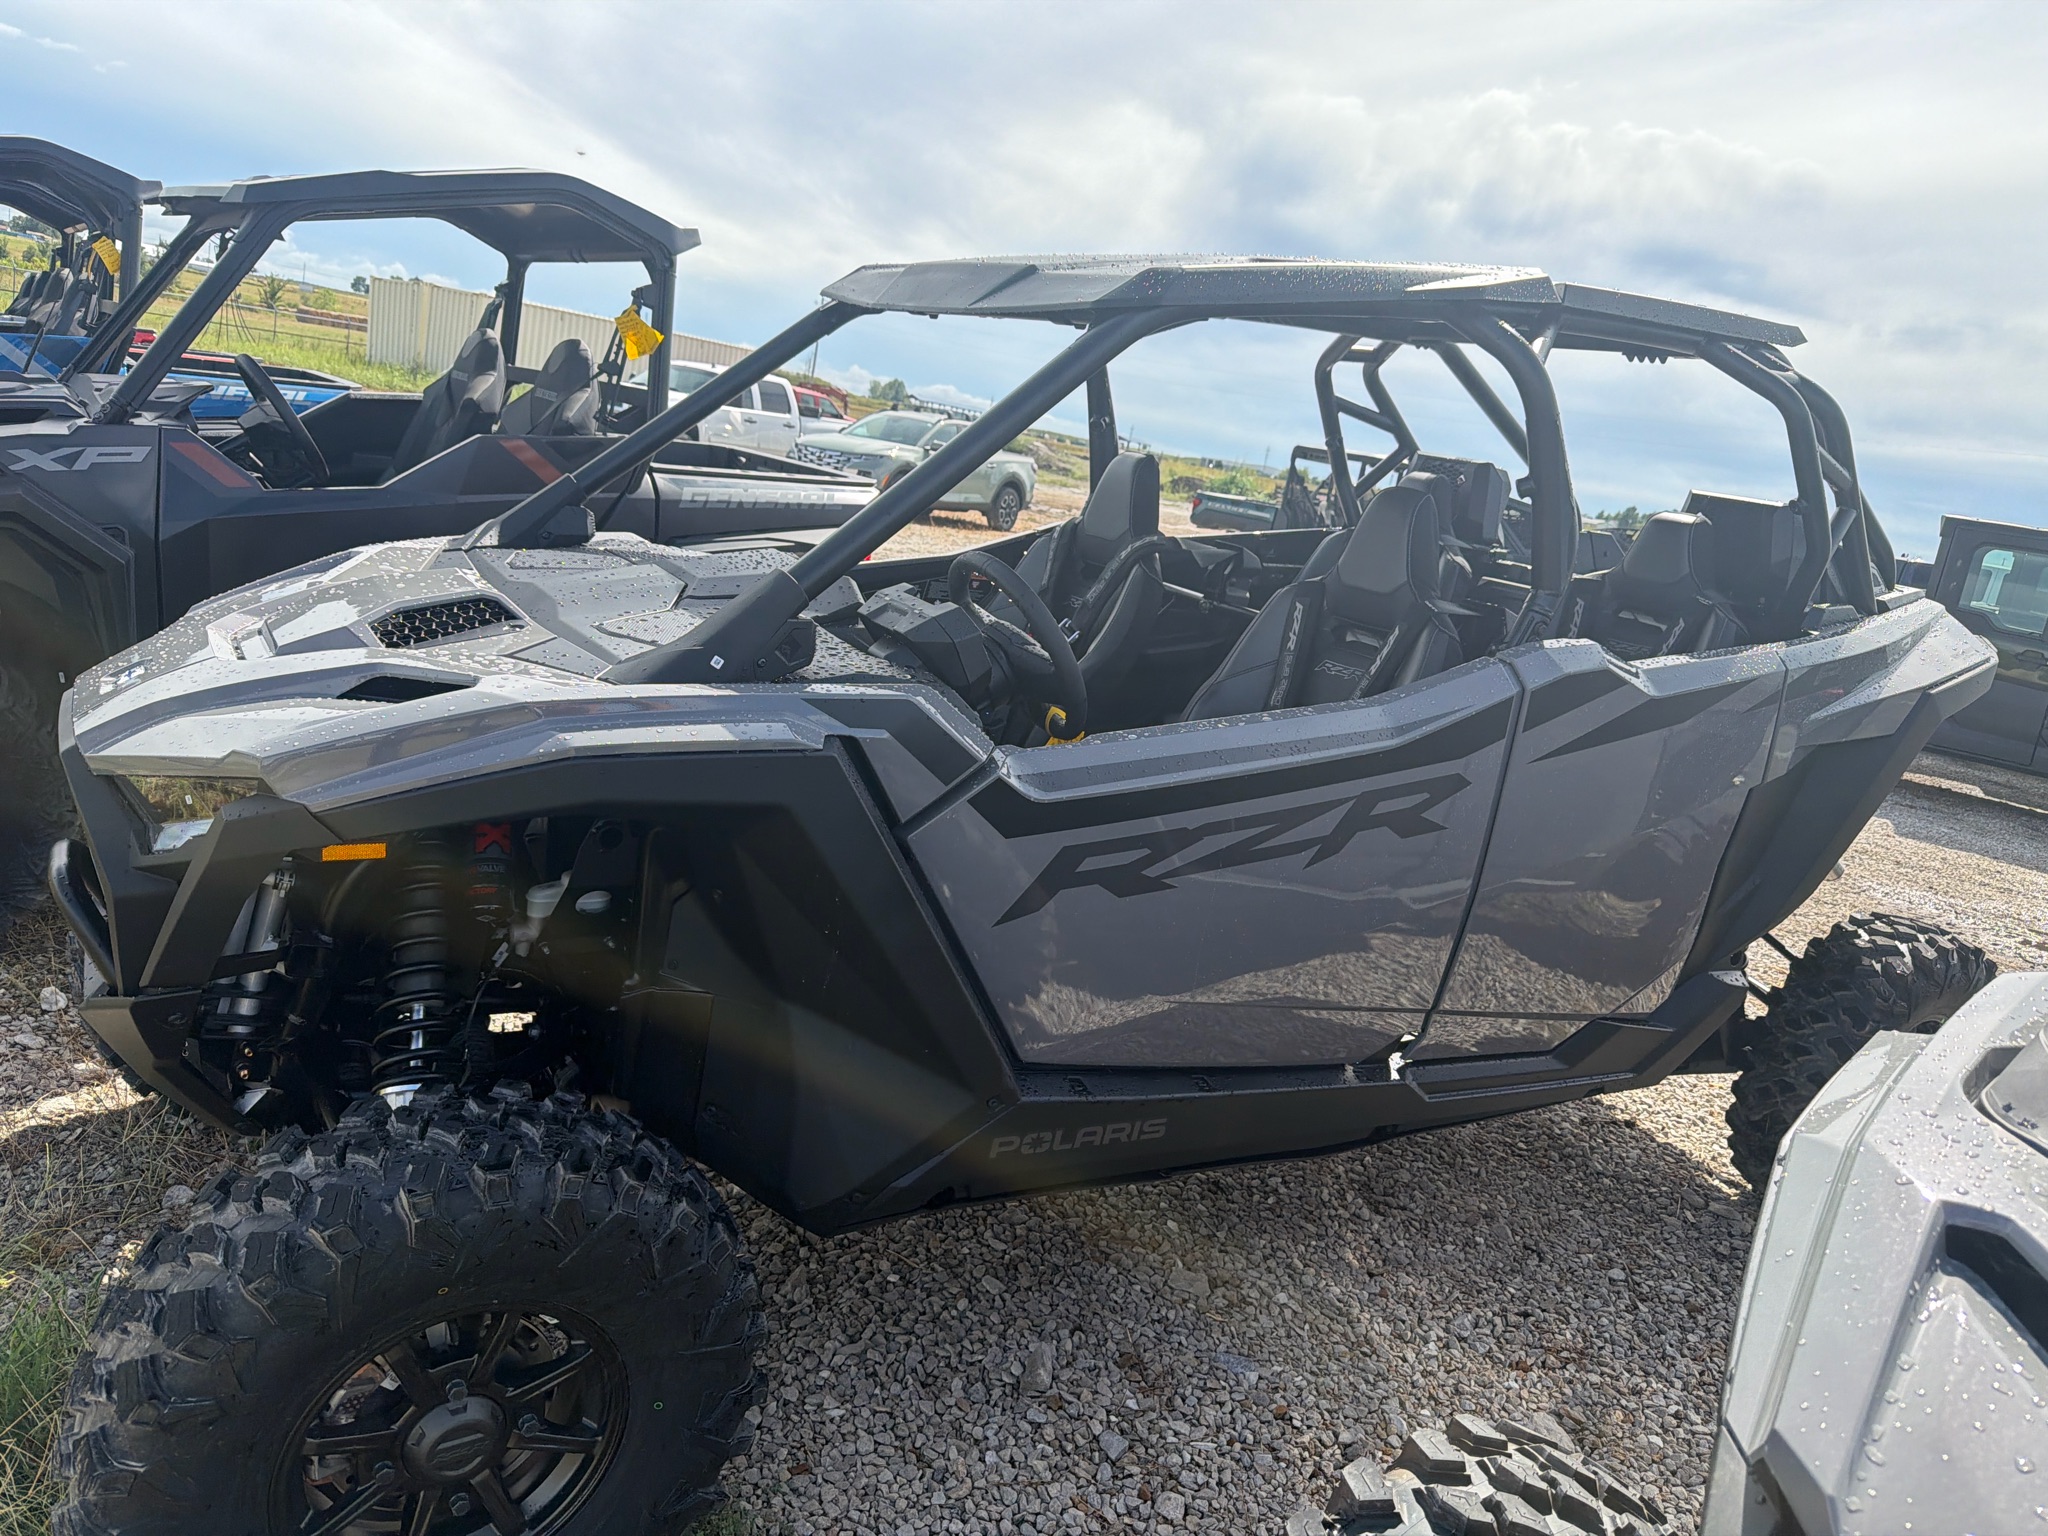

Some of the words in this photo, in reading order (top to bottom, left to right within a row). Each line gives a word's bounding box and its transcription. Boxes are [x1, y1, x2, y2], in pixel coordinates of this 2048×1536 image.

[7, 446, 152, 471] XP
[679, 487, 842, 510] GENERAL
[1286, 601, 1303, 651] RZR
[991, 773, 1472, 928] RZR
[989, 1118, 1168, 1159] POLARIS
